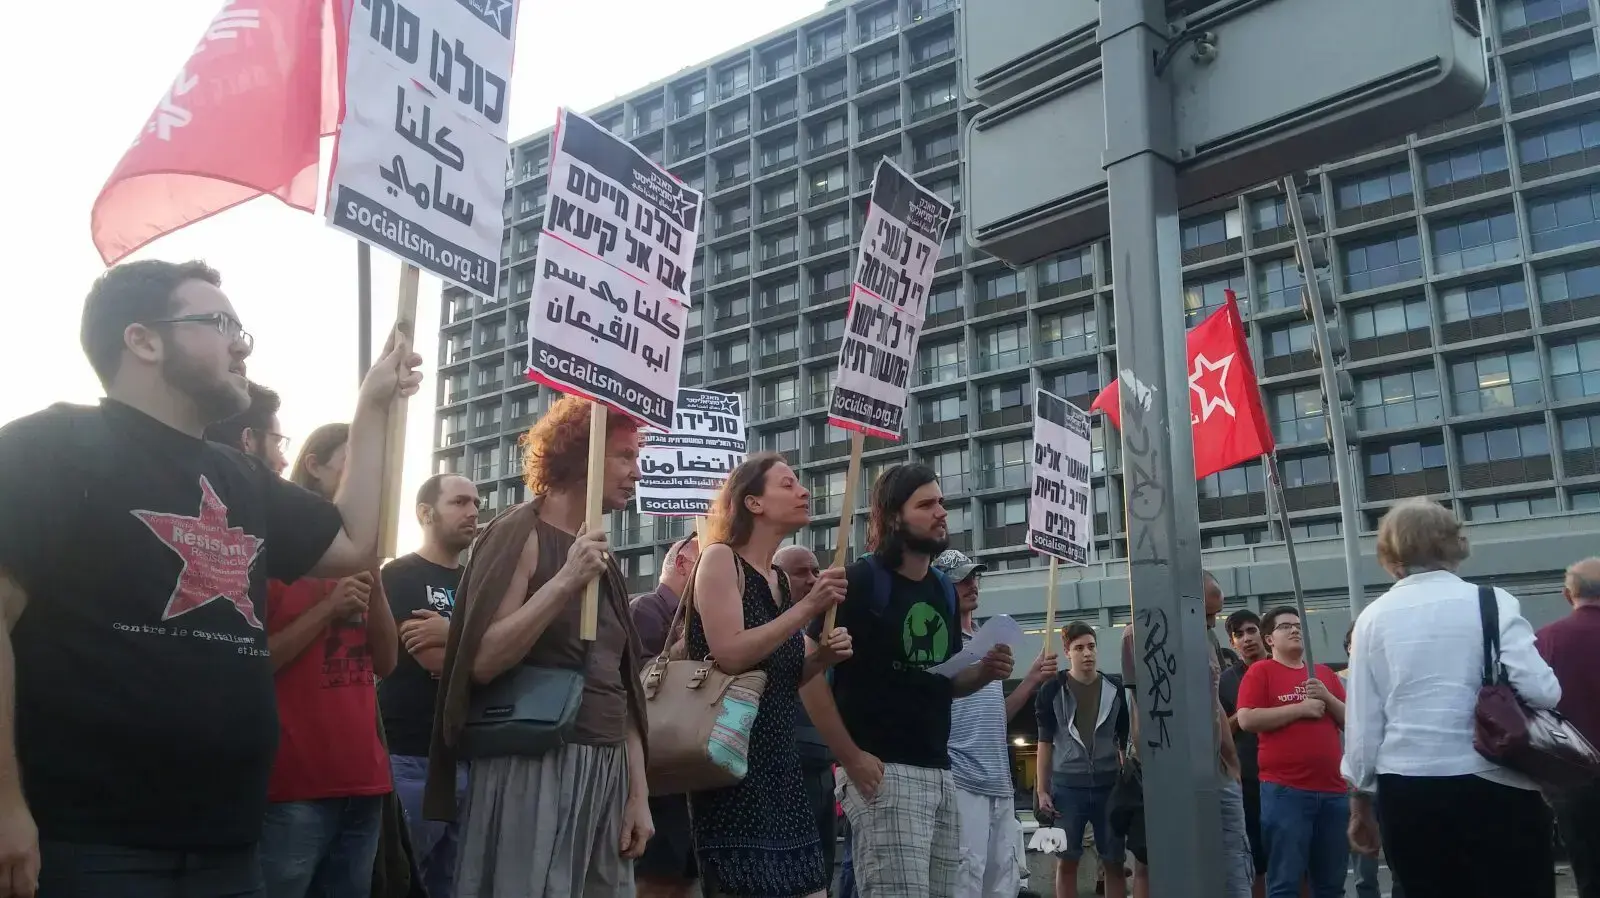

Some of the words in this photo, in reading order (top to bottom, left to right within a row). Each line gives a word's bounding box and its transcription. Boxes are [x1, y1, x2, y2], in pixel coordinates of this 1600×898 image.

[429, 28, 507, 125] כולנו
[395, 84, 465, 172] كلنا
[379, 154, 474, 227] سامي
[566, 163, 630, 222] מייסם
[346, 201, 489, 286] socialism.org.il
[548, 194, 618, 257] קיעאן
[634, 203, 682, 256] כולנו
[624, 227, 653, 273] אל
[915, 241, 931, 276] די
[656, 253, 687, 296] אבו
[633, 289, 680, 340] كلنا
[910, 282, 925, 314] די
[546, 294, 639, 354] القيعان
[641, 344, 671, 373] ابو
[539, 349, 667, 419] socialism.org.il
[834, 394, 899, 426] socialism.org.il
[1034, 442, 1062, 473] אלים
[1034, 474, 1067, 506] להיות
[1068, 488, 1088, 516] חייב
[1034, 534, 1084, 561] socialism.org.il
[112, 622, 166, 635] Contre
[170, 626, 188, 637] le
